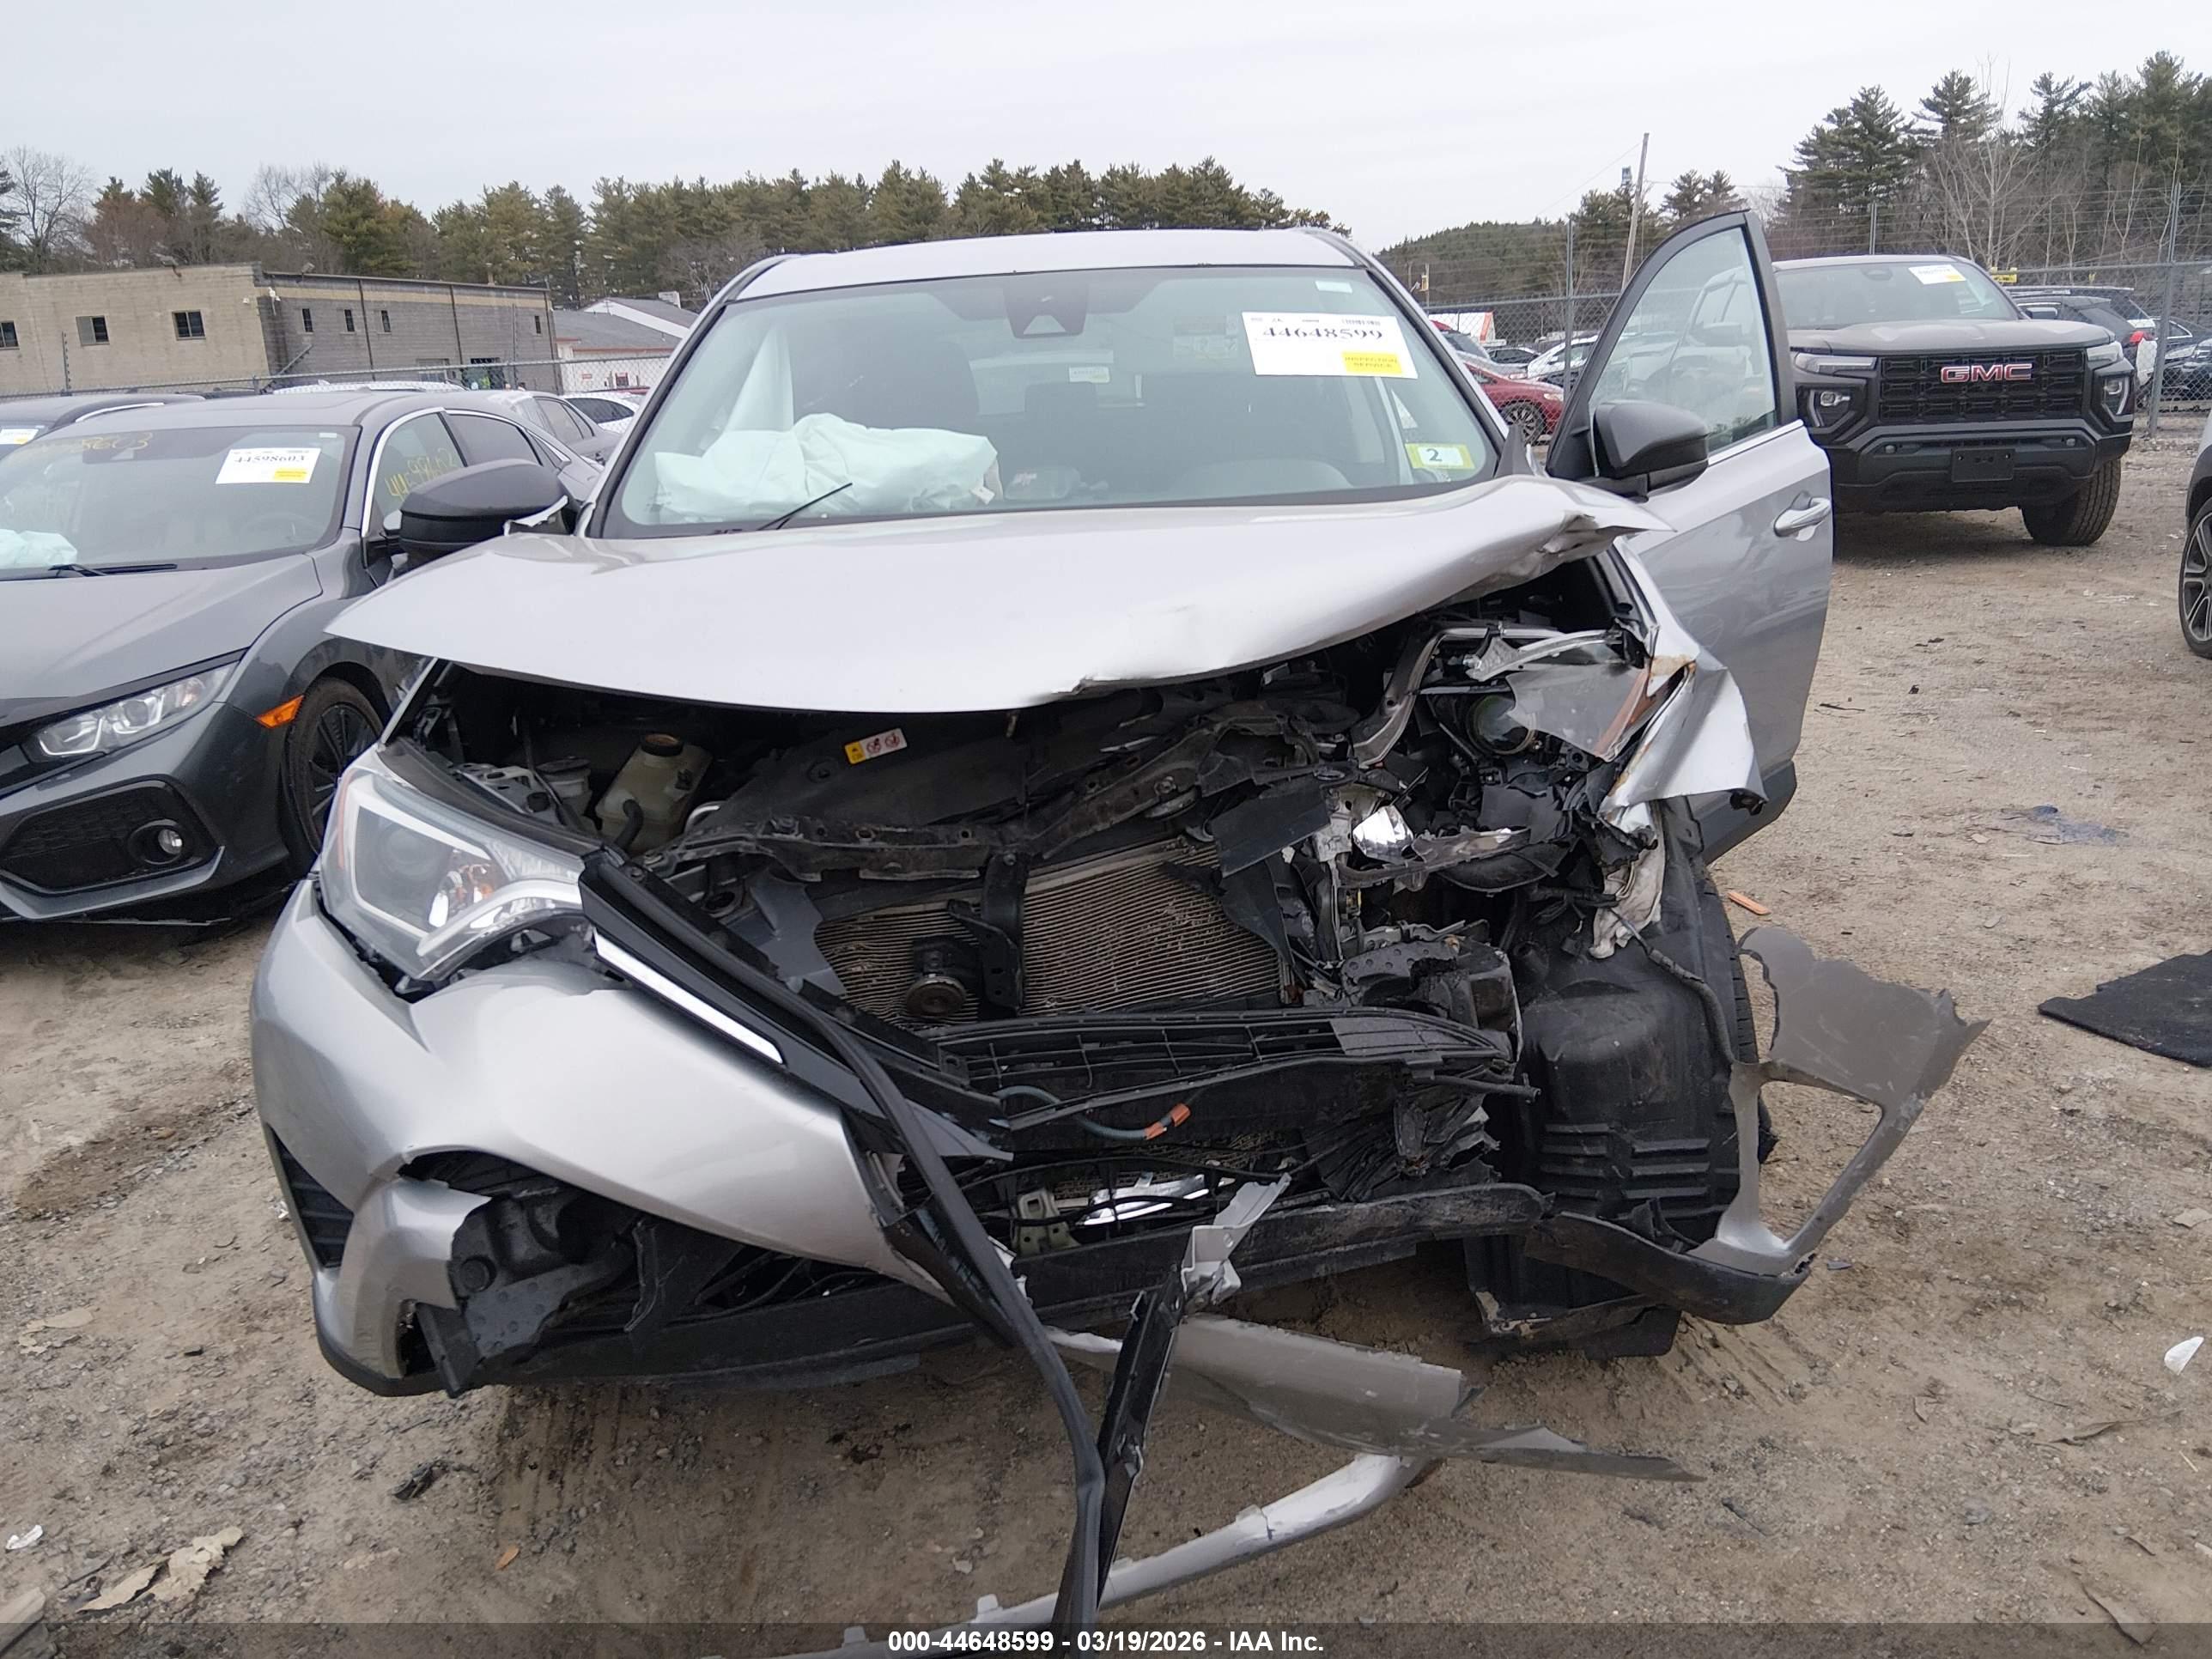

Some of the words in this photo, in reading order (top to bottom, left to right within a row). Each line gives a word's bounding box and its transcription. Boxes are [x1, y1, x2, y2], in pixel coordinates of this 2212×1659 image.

[1263, 326, 1383, 339] 44648599
[1940, 362, 2033, 384] GMC
[1426, 447, 1443, 463] 2
